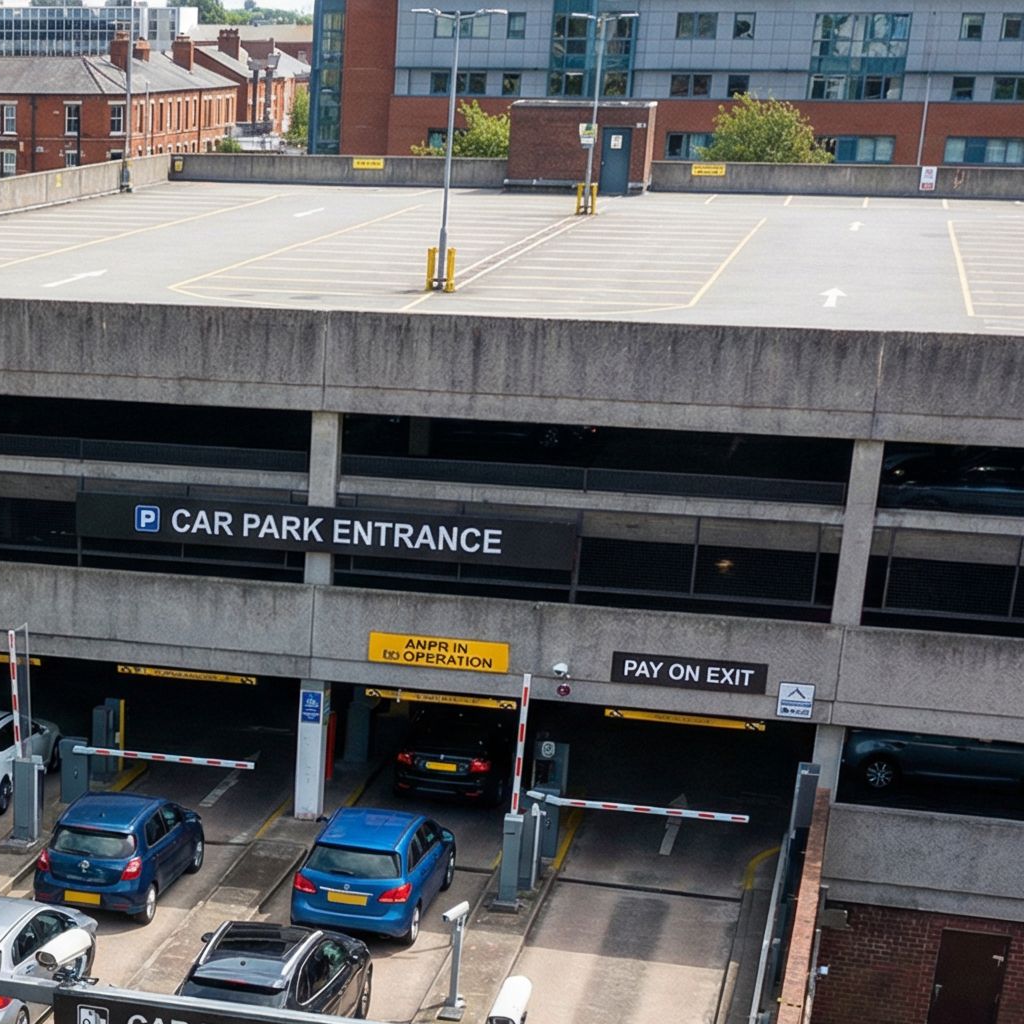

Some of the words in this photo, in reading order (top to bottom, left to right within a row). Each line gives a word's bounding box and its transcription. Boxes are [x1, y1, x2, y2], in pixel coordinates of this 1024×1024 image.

[171, 508, 234, 537] CAR
[242, 512, 325, 543] PARK
[332, 518, 504, 555] ENTRANCE
[404, 638, 449, 653] ANPR
[453, 642, 469, 655] IN
[402, 650, 494, 669] OPERATION
[623, 659, 664, 679] PAY
[668, 663, 701, 683] ON
[705, 666, 756, 687] EXIT
